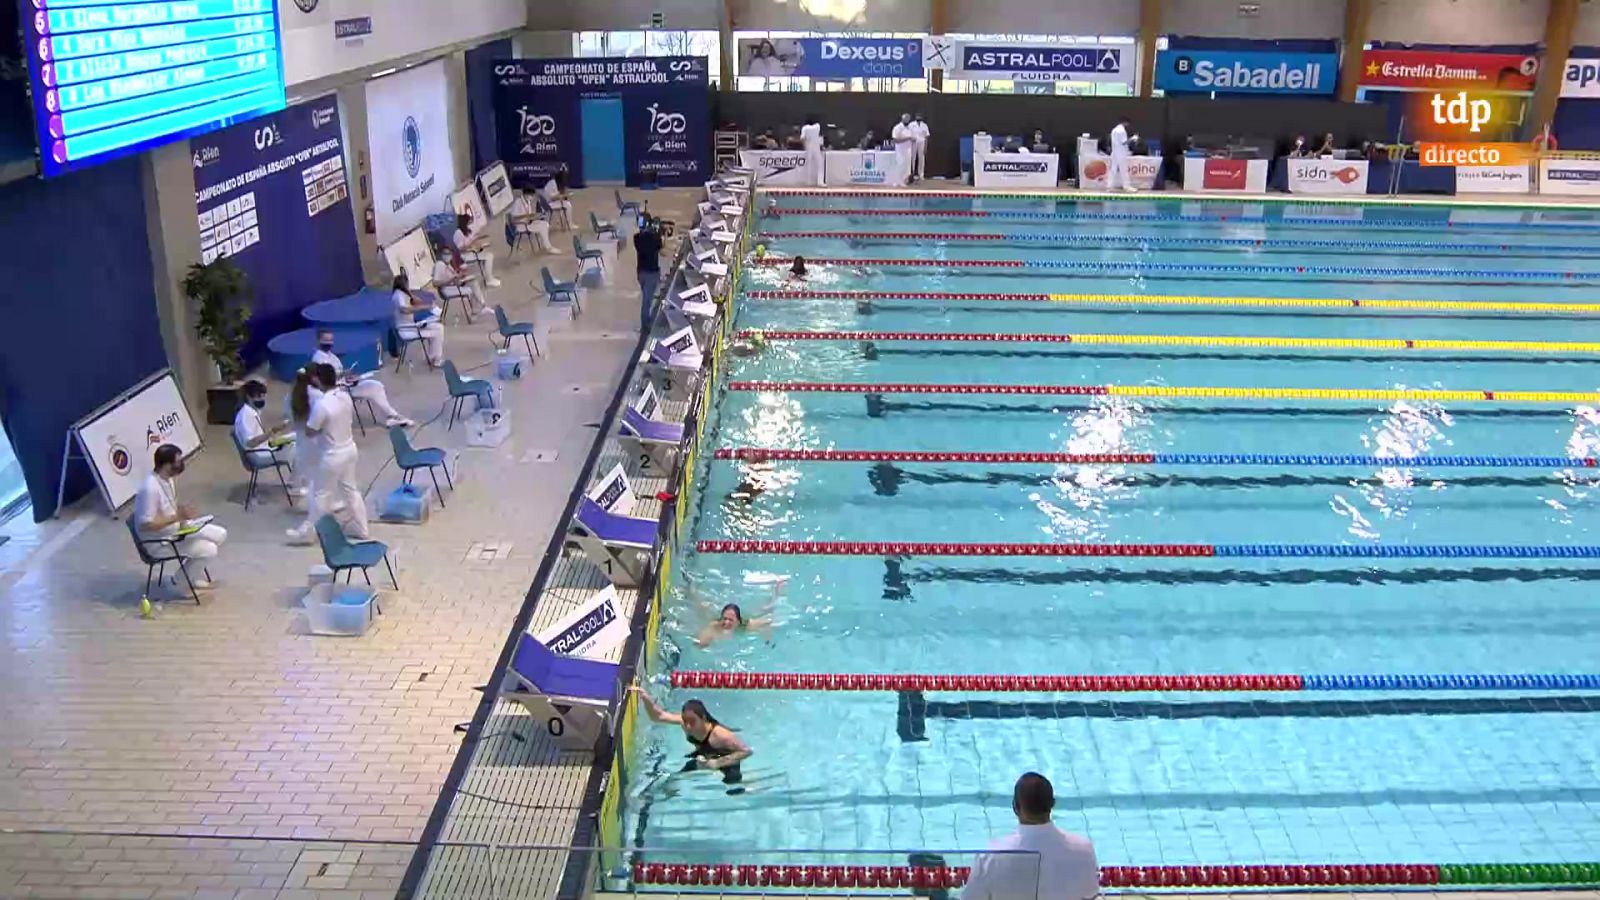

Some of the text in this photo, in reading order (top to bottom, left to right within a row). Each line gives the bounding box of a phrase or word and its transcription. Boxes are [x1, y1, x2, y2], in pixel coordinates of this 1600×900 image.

[35, 13, 45, 29] 5
[38, 40, 49, 56] 6
[821, 41, 904, 60] Dexeus
[544, 62, 604, 75] CAMPEONATO
[607, 62, 619, 73] DE
[621, 60, 657, 73] ESPAÑA
[967, 53, 1092, 67] ASTRALPOOL
[42, 65, 52, 82] 7
[1193, 60, 1320, 89] Sabadell
[1382, 61, 1478, 80] Estrella Damm
[1566, 64, 1600, 88] ap
[531, 74, 575, 86] ABSOLUTO
[577, 74, 610, 85] "OPEN"
[612, 73, 669, 84] ASTRALPOOL
[759, 155, 806, 168] speedo
[984, 163, 1037, 172] ASTRALPOOL
[195, 177, 237, 203] CAMPEONATO
[236, 174, 246, 186] DE
[245, 163, 268, 183] ESPAÑA
[267, 155, 296, 175] ABSOLUTO
[1296, 166, 1327, 179] sidn
[663, 379, 672, 390] 3
[639, 454, 651, 469] 2
[603, 558, 613, 575] 1
[549, 615, 603, 655] TRALPOOL
[547, 717, 564, 736] 0
